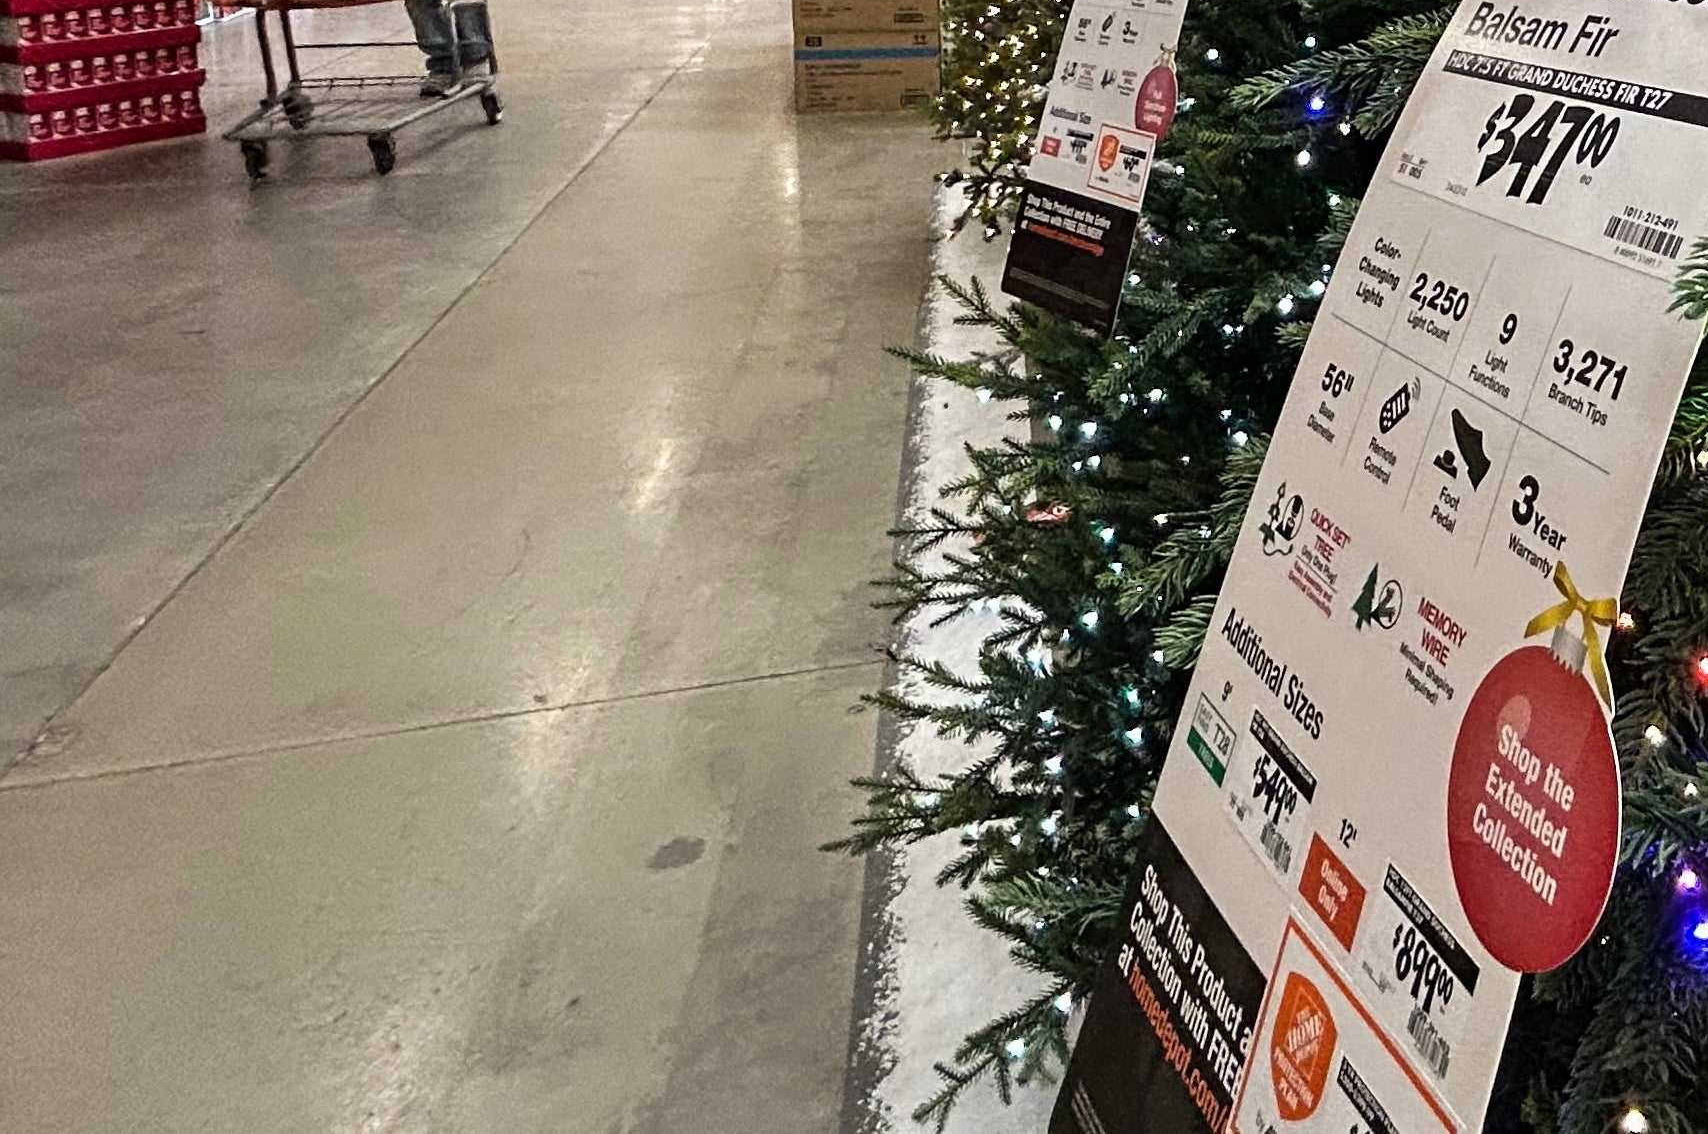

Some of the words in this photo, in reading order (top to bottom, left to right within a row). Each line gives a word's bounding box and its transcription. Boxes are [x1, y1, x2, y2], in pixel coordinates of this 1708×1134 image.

[1464, 1, 1570, 51] Balsam
[1568, 14, 1619, 57] Fir
[1448, 52, 1473, 71] HDC
[1472, 56, 1493, 74] 7.5
[1491, 60, 1508, 78] FT
[1507, 63, 1553, 88] GRAND
[1551, 69, 1615, 99] DUCHESS
[1614, 82, 1640, 106] FIR
[1639, 87, 1674, 111] T27
[1623, 204, 1679, 232] 1011-212-491
[1358, 256, 1400, 291] Changing
[1355, 281, 1386, 310] Lights
[1409, 272, 1470, 322] 2,250
[1406, 309, 1428, 334] Light
[1426, 318, 1452, 343] Count
[1498, 313, 1518, 345] 9
[1484, 350, 1509, 375] Light
[1552, 338, 1629, 402] 3,271
[1467, 364, 1511, 399] Functions
[1547, 382, 1585, 414] Branch
[1582, 395, 1609, 428] Tips
[1367, 436, 1398, 466] Remote
[1362, 456, 1391, 486] Control
[1438, 485, 1461, 512] Foot
[1511, 474, 1541, 526] 3
[1532, 510, 1568, 553] Year
[1309, 507, 1336, 533] QUICK
[1430, 507, 1457, 535] Pedal
[1313, 534, 1335, 563] TREE
[1507, 532, 1555, 580] Warranty
[1417, 596, 1468, 649] MEMORY
[1421, 628, 1451, 668] WIRE
[1221, 607, 1284, 698] Additional
[1282, 671, 1325, 741] Sizes
[1424, 664, 1456, 701] Shaping
[1497, 723, 1542, 786] Shop
[1546, 762, 1576, 812] the
[1485, 761, 1568, 859] Extended
[1339, 818, 1358, 850] 12'
[1472, 802, 1558, 906] Collection
[1320, 857, 1349, 904] Online
[1317, 884, 1338, 921] Only
[1118, 943, 1135, 978] at
[1141, 864, 1170, 927] Shop
[1166, 904, 1194, 964] This
[1190, 943, 1245, 1042] Product
[1130, 901, 1183, 1005] Collection
[1179, 989, 1211, 1051] with
[1287, 1014, 1322, 1052] HOME
